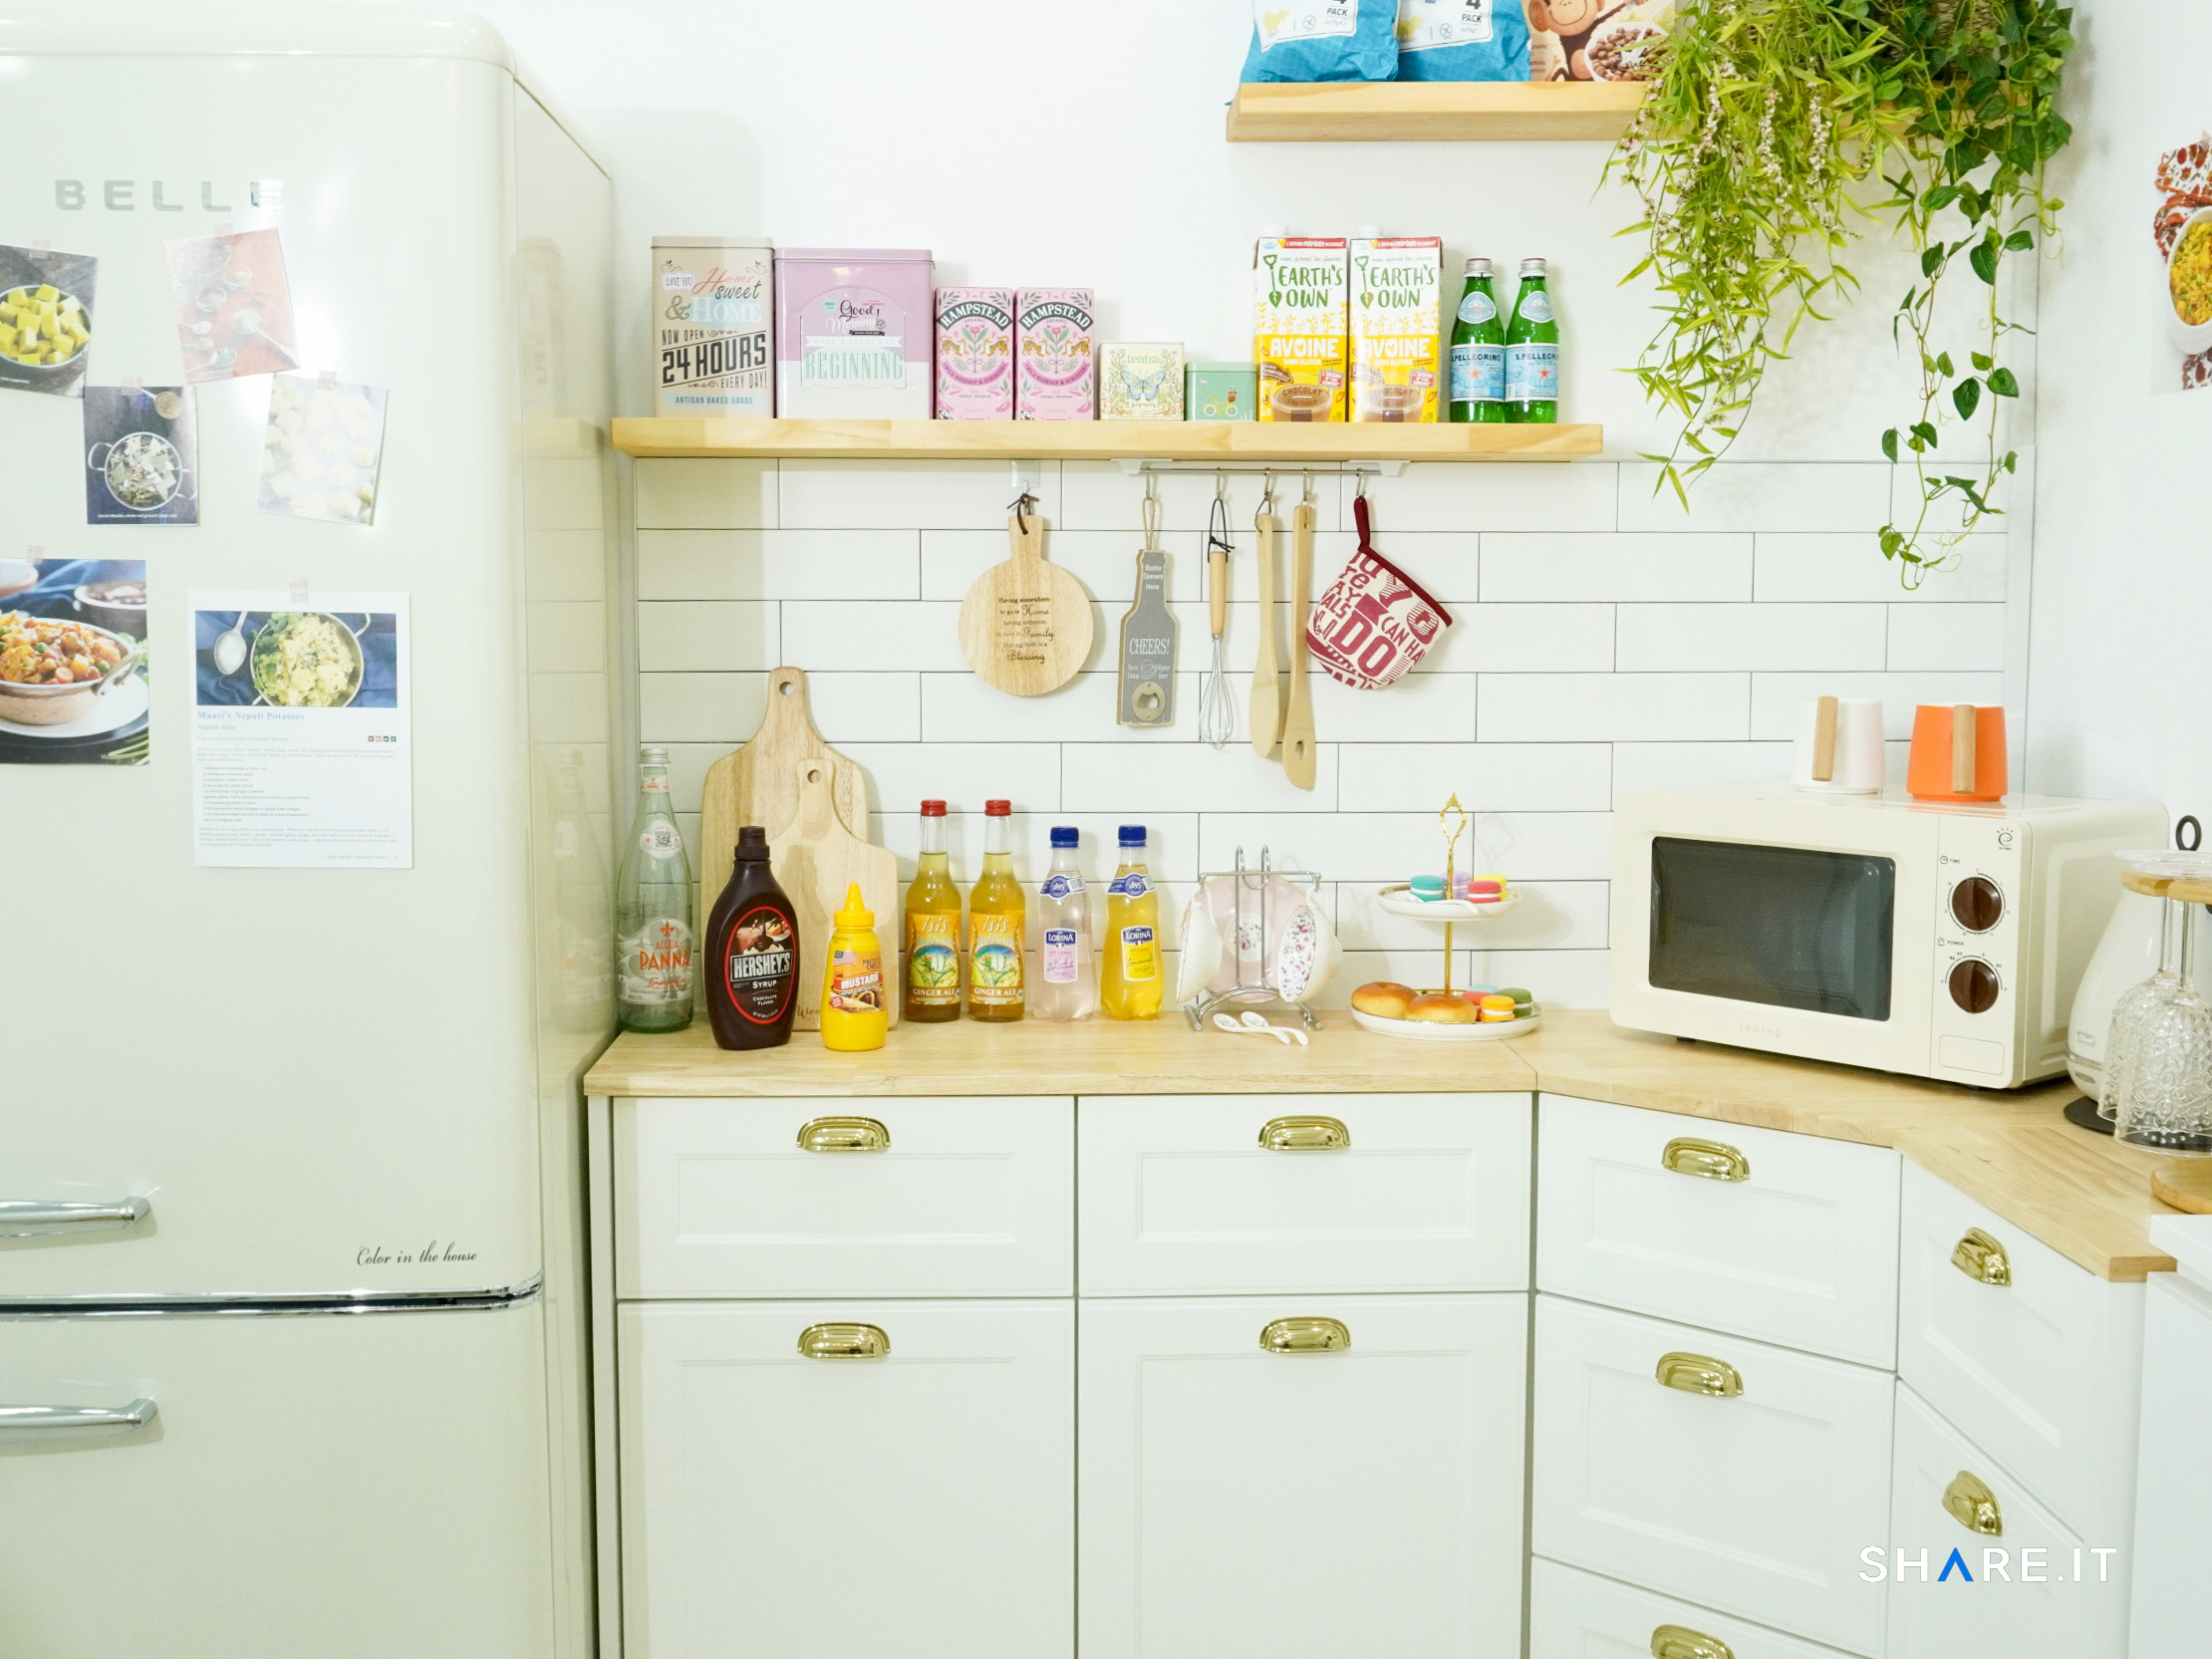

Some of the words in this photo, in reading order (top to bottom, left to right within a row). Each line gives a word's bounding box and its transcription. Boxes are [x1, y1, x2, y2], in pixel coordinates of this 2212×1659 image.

[1462, 14, 1482, 23] PACK
[692, 267, 754, 295] Home
[1278, 265, 1343, 287] EARTH'S
[1370, 265, 1436, 287] EARTH'S
[714, 281, 761, 300] sweet
[1285, 288, 1329, 308] OWN
[1377, 289, 1421, 309] OWN
[665, 295, 691, 321] &
[691, 300, 761, 323] HOME
[941, 303, 1009, 328] HAMPSTEAD
[1022, 304, 1091, 329] HAMPSTEAD
[825, 317, 877, 334] Morning
[662, 330, 680, 345] NOW
[684, 330, 704, 343] OPEN
[1270, 338, 1339, 357] AVOINE
[1363, 338, 1431, 358] AVOINE
[663, 348, 691, 384] 24
[695, 334, 766, 377] HOURS
[804, 352, 903, 380] BEGINNING
[720, 376, 744, 389] EVERY
[748, 371, 767, 389] DAY!
[1282, 387, 1323, 396] CHOCOLAT
[1022, 604, 1049, 616] Home
[1022, 627, 1054, 641] Family
[1381, 616, 1410, 648] CAN
[1404, 640, 1426, 664] HA
[1130, 638, 1170, 655] CHEERS!
[1329, 610, 1397, 678] DO
[1006, 650, 1045, 665] Blessing
[235, 711, 263, 720] Nepali
[923, 916, 949, 933] isis
[982, 916, 1009, 933] isis
[656, 940, 680, 950] ACQUA
[1126, 931, 1151, 940] LORINA
[640, 950, 690, 970] PANNA
[733, 953, 790, 978] HERSHEY'S
[841, 973, 879, 989] MUSTARD
[797, 1004, 821, 1019] Woo
[357, 1245, 391, 1265] Color
[398, 1250, 413, 1263] in
[419, 1240, 438, 1262] the
[443, 1242, 477, 1261] house
